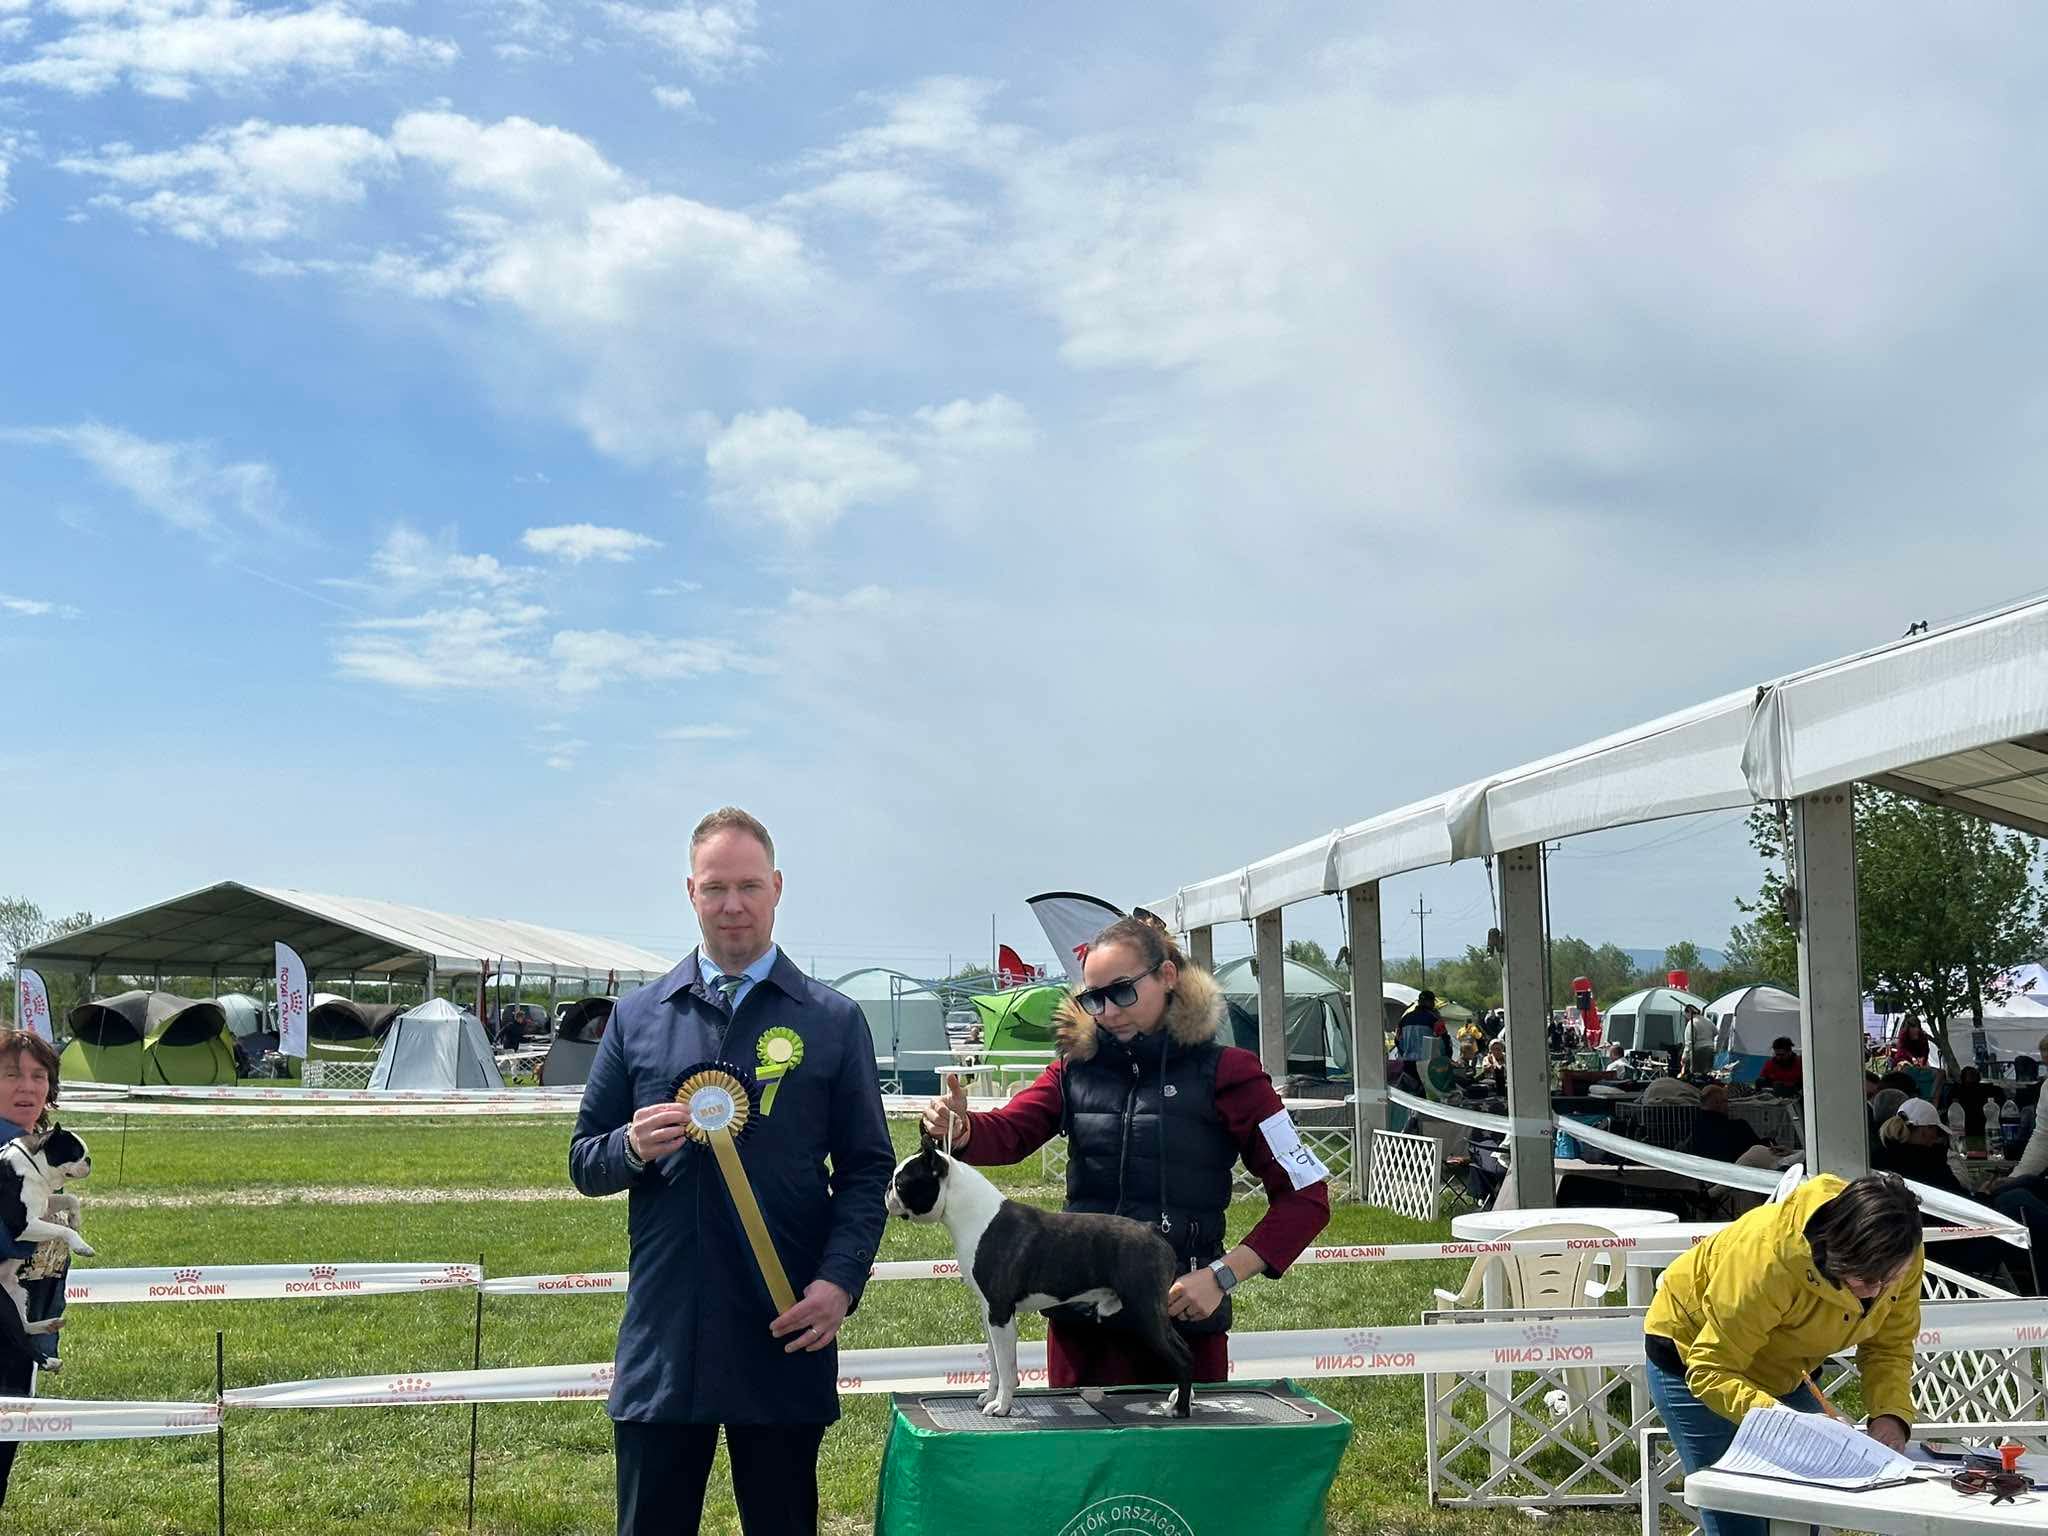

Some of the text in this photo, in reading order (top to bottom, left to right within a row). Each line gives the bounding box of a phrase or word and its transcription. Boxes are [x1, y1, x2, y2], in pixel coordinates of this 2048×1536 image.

[280, 966, 289, 998] ROYAL
[1441, 1242, 1511, 1254] ROYAL CANIN
[1566, 1238, 1636, 1249] ROYAL CANIN
[1315, 1247, 1386, 1259] ROYAL CANIN
[286, 1280, 361, 1293] ROYAL CANIN
[538, 1278, 612, 1290] ROYAL CANIN
[66, 1287, 89, 1299] NIN
[149, 1284, 226, 1297] ROYAL CANIN
